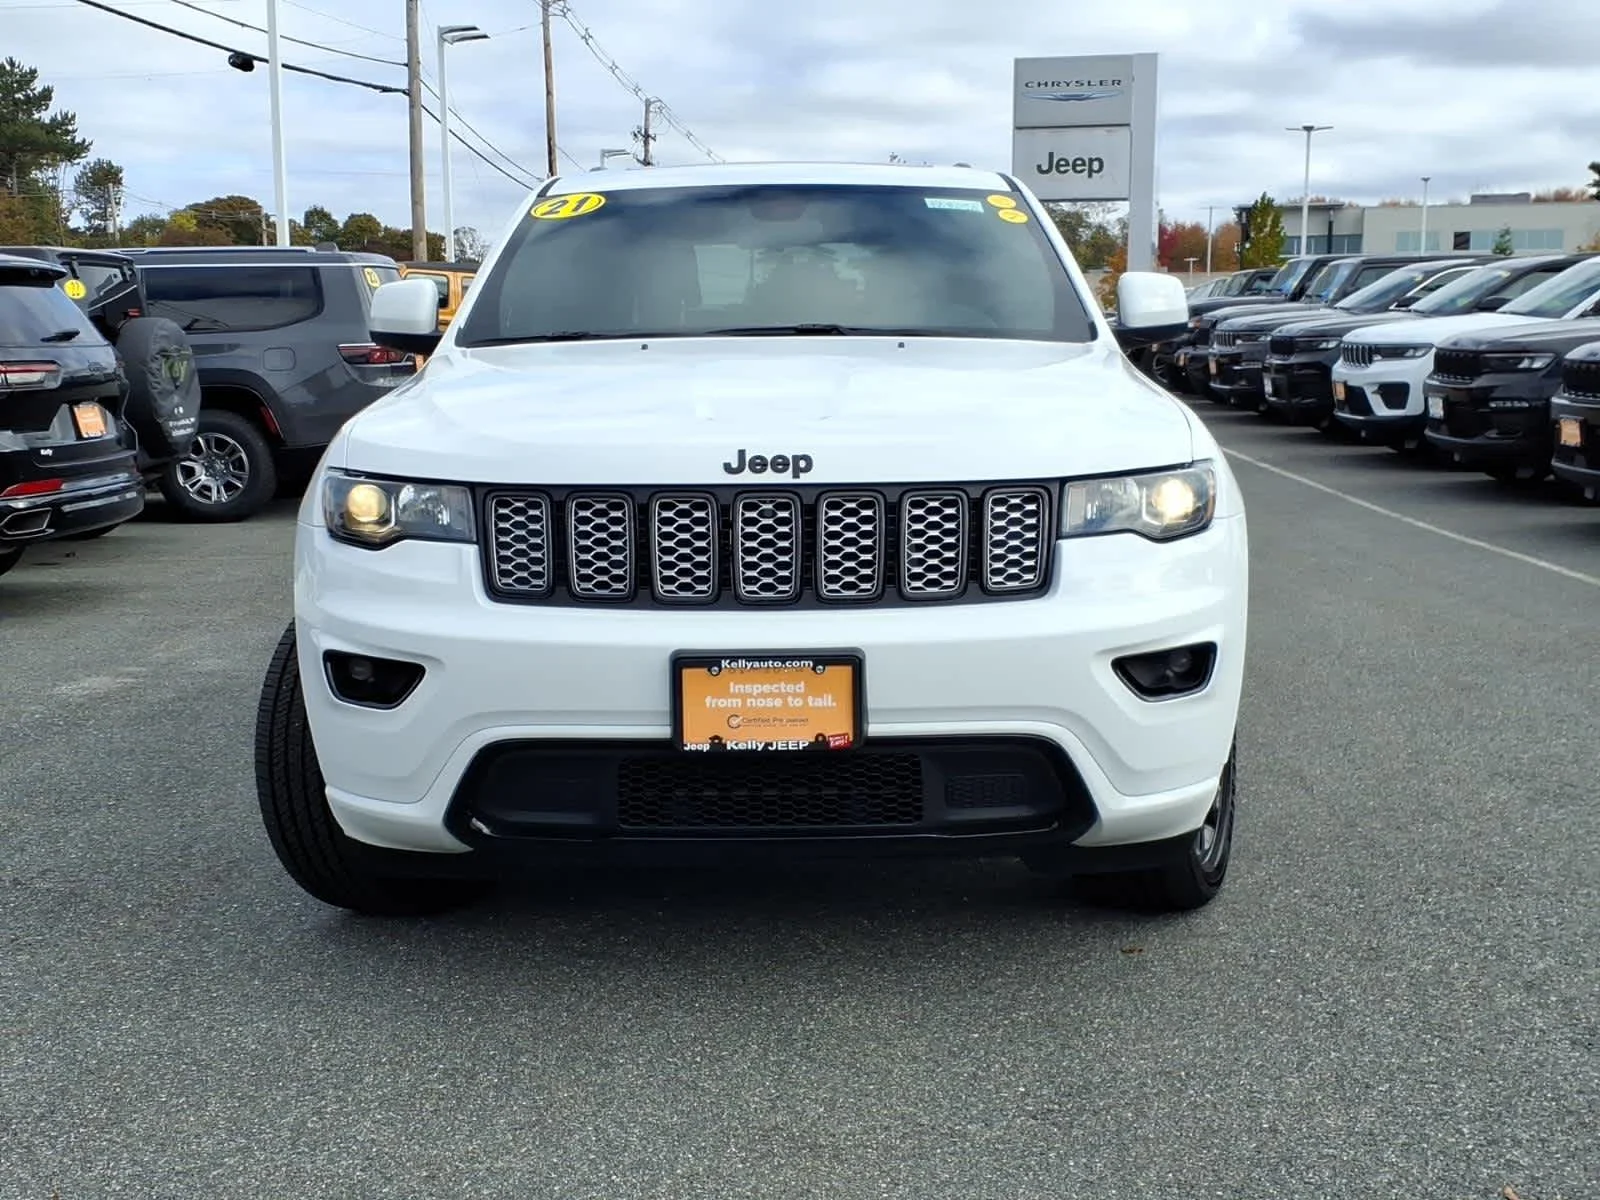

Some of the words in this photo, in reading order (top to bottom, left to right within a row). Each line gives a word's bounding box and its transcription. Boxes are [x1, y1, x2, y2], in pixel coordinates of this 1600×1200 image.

[1024, 79, 1122, 89] CHRYSLER
[1036, 152, 1104, 179] Jeep
[540, 196, 591, 216] 21
[723, 449, 813, 479] Jeep
[721, 659, 813, 669] Kellyauto.com
[730, 682, 804, 695] Inspected
[705, 696, 741, 708] from
[747, 698, 783, 707] nose
[787, 697, 803, 707] to
[808, 695, 836, 707] tail.
[684, 742, 710, 752] Jeep
[727, 740, 764, 751] Kelly
[768, 740, 809, 750] JEEP
